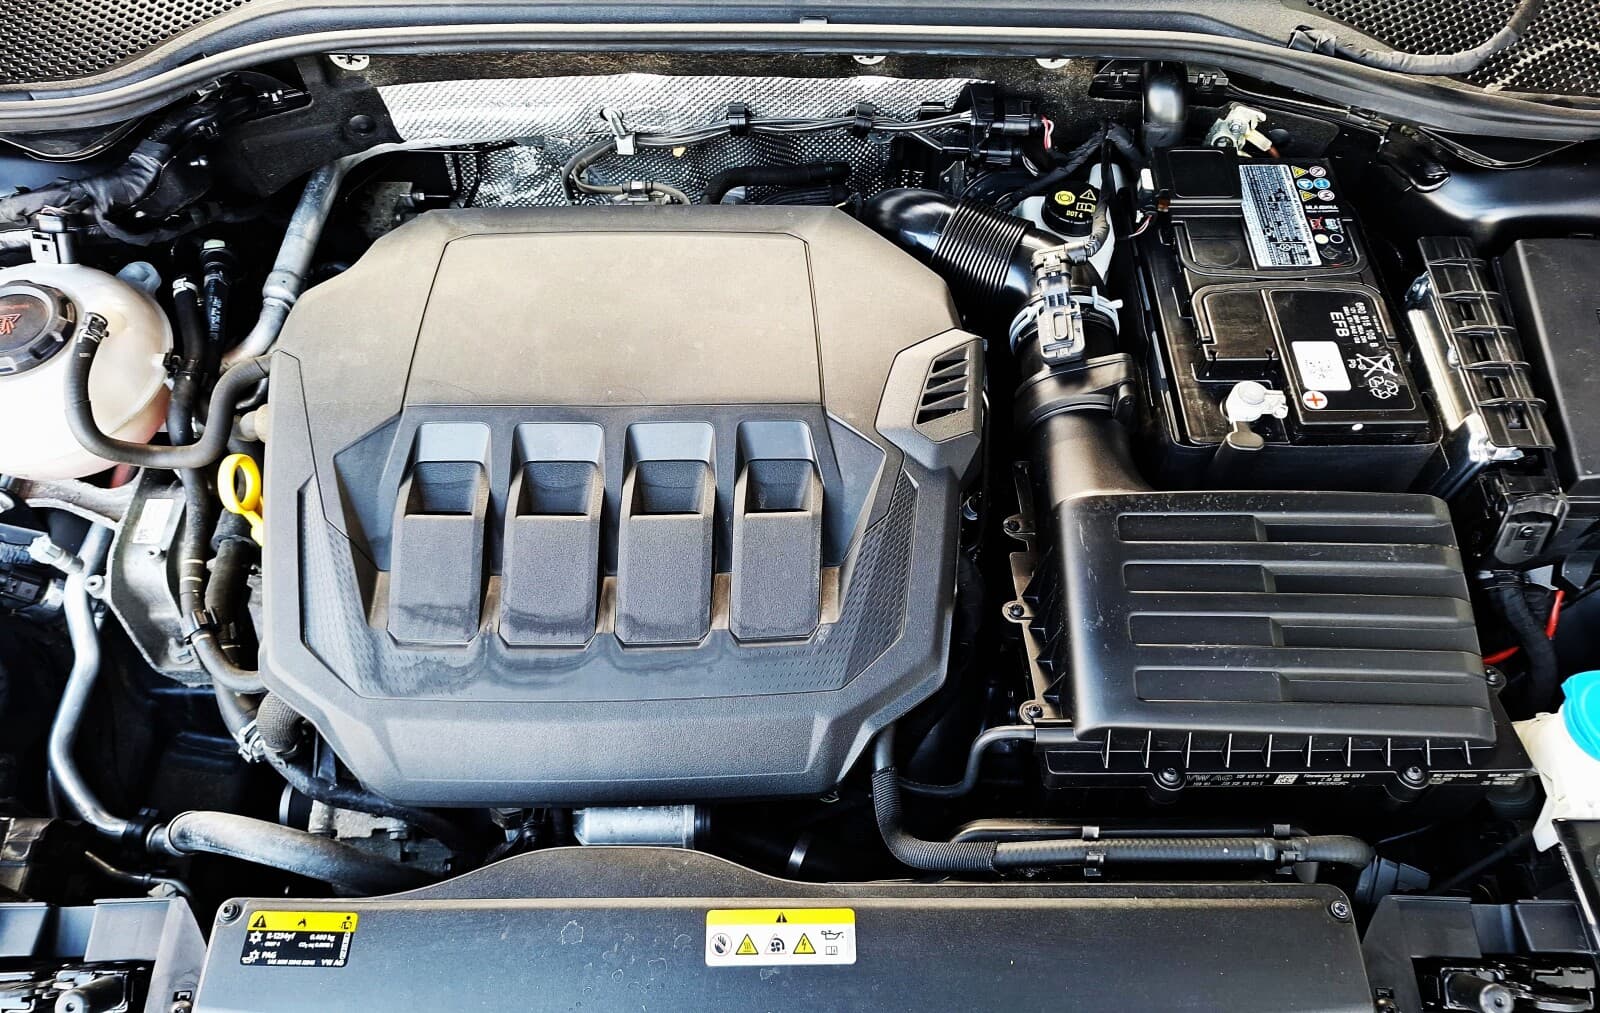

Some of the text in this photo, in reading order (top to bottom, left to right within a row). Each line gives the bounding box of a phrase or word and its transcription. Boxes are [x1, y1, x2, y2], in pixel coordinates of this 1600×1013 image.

[1330, 312, 1350, 336] EFB
[1347, 359, 1357, 369] Pb
[261, 951, 277, 959] PAG
[321, 958, 334, 966] VW
[333, 958, 345, 966] AG
